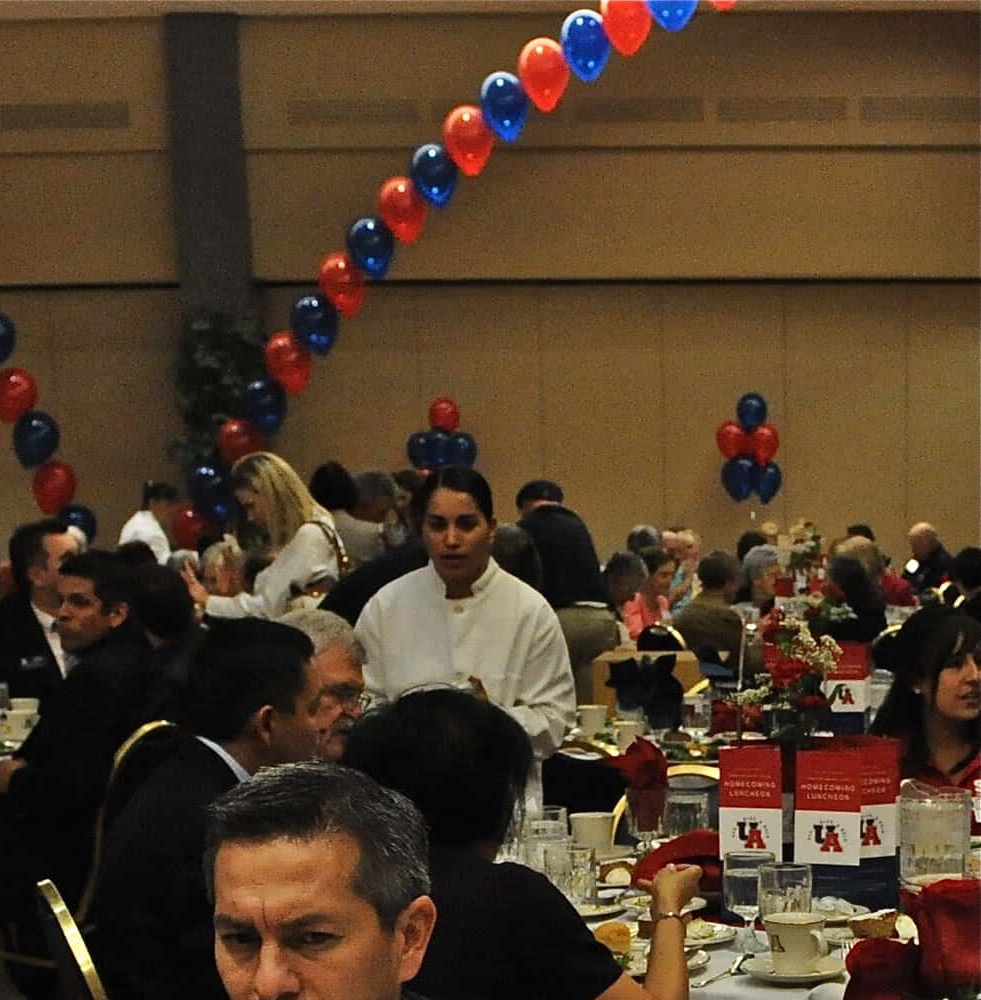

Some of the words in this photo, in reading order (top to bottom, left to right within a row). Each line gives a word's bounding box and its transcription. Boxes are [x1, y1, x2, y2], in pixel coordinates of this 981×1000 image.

[723, 780, 776, 789] HOMECOMING
[800, 783, 856, 792] HOMECOMING
[729, 790, 771, 798] LUNCHEON
[806, 793, 851, 801] LUNCHEON
[736, 821, 766, 849] UA
[813, 824, 843, 852] UA
